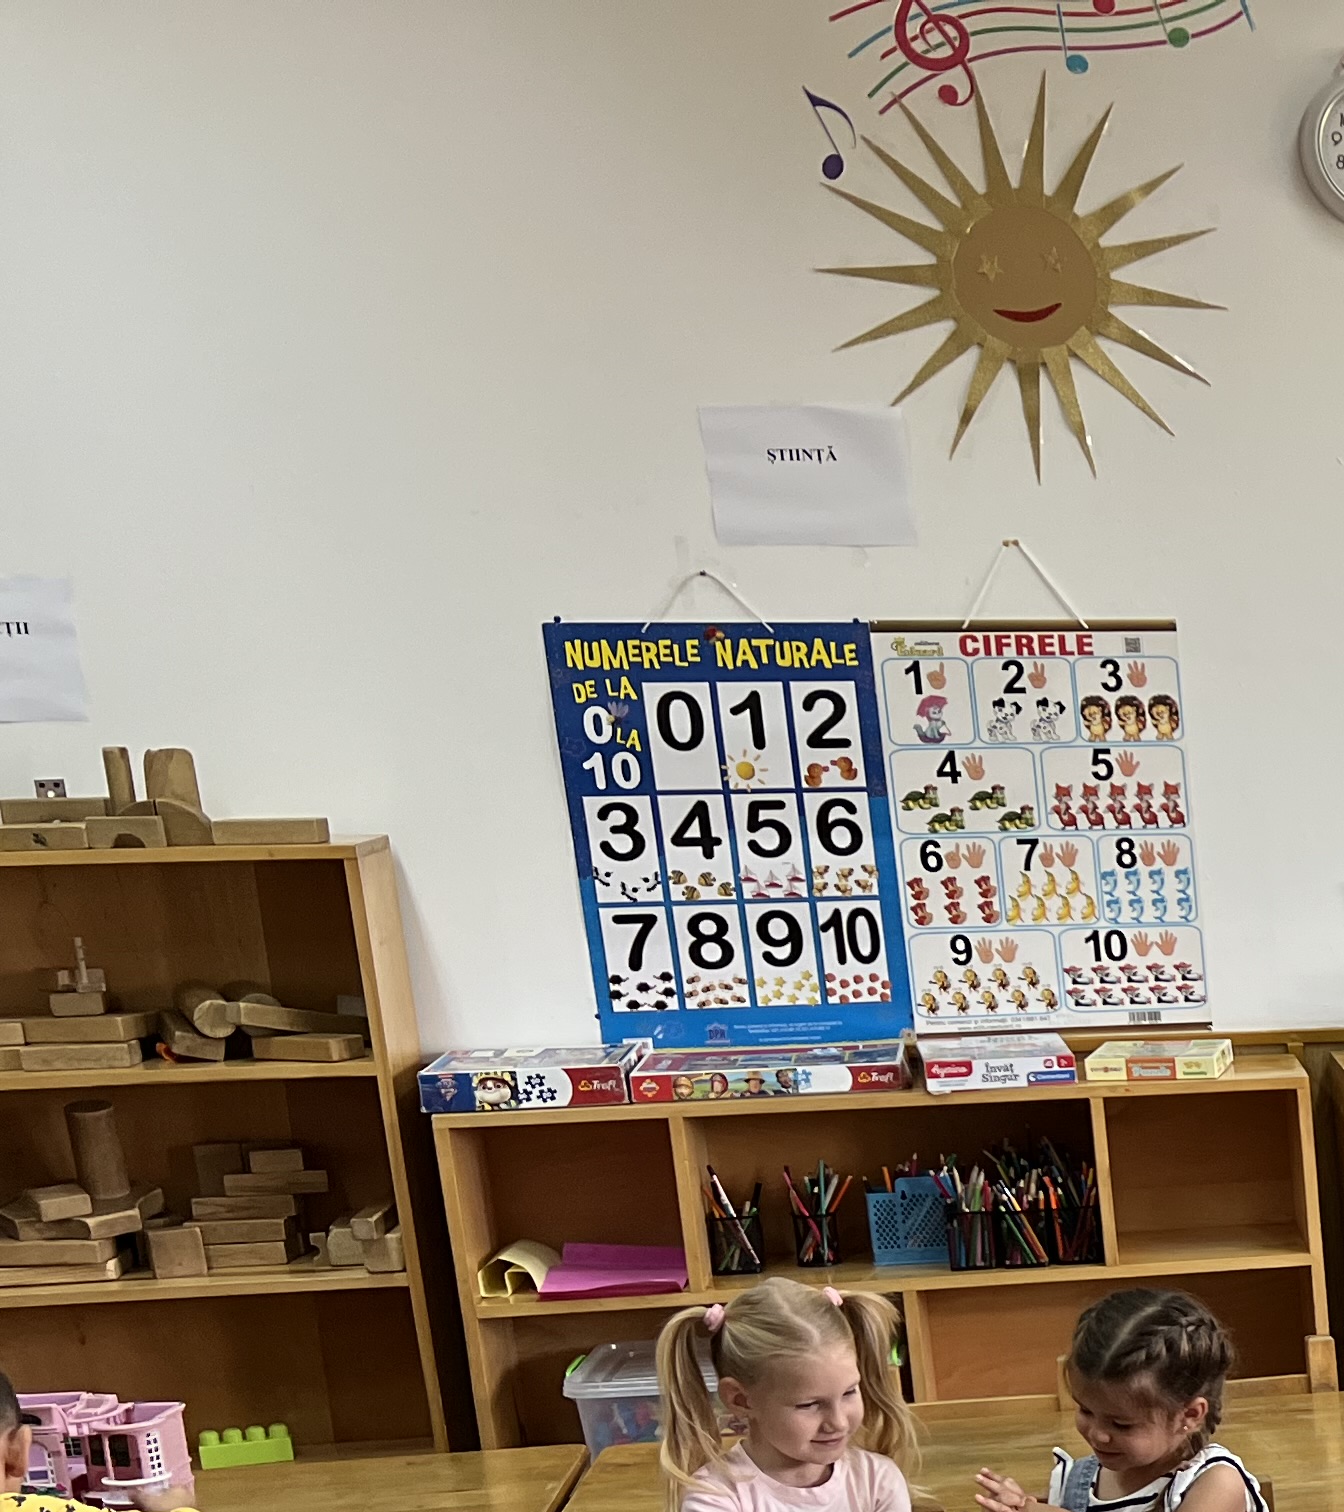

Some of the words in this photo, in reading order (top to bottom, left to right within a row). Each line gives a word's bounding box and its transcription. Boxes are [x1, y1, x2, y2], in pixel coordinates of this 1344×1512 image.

[1331, 131, 1342, 146] 9
[1336, 154, 1344, 169] 8
[0, 621, 29, 637] ȚII
[958, 634, 1094, 657] CIFRELE
[564, 639, 701, 671] NUMERELE
[716, 638, 859, 669] NATURALE
[572, 680, 597, 704] DE
[605, 676, 638, 700] LA
[904, 660, 923, 695] 1
[1001, 659, 1027, 694] 2
[1100, 659, 1123, 692] 3
[583, 705, 612, 744] 0
[616, 727, 641, 752] LA
[656, 690, 704, 751] 0
[730, 690, 766, 750] 1
[802, 689, 852, 749] 2
[582, 751, 641, 790] 10
[936, 750, 962, 784] 4
[1091, 748, 1114, 781] 5
[597, 802, 646, 861] 3
[670, 800, 722, 860] 4
[746, 800, 792, 858] 5
[816, 798, 863, 856] 6
[919, 839, 943, 873] 6
[1016, 838, 1039, 872] 7
[1115, 837, 1137, 869] 8
[611, 914, 658, 972] 7
[686, 912, 735, 970] 8
[756, 910, 803, 967] 9
[819, 907, 881, 965] 10
[949, 934, 973, 966] 9
[1084, 929, 1128, 962] 10
